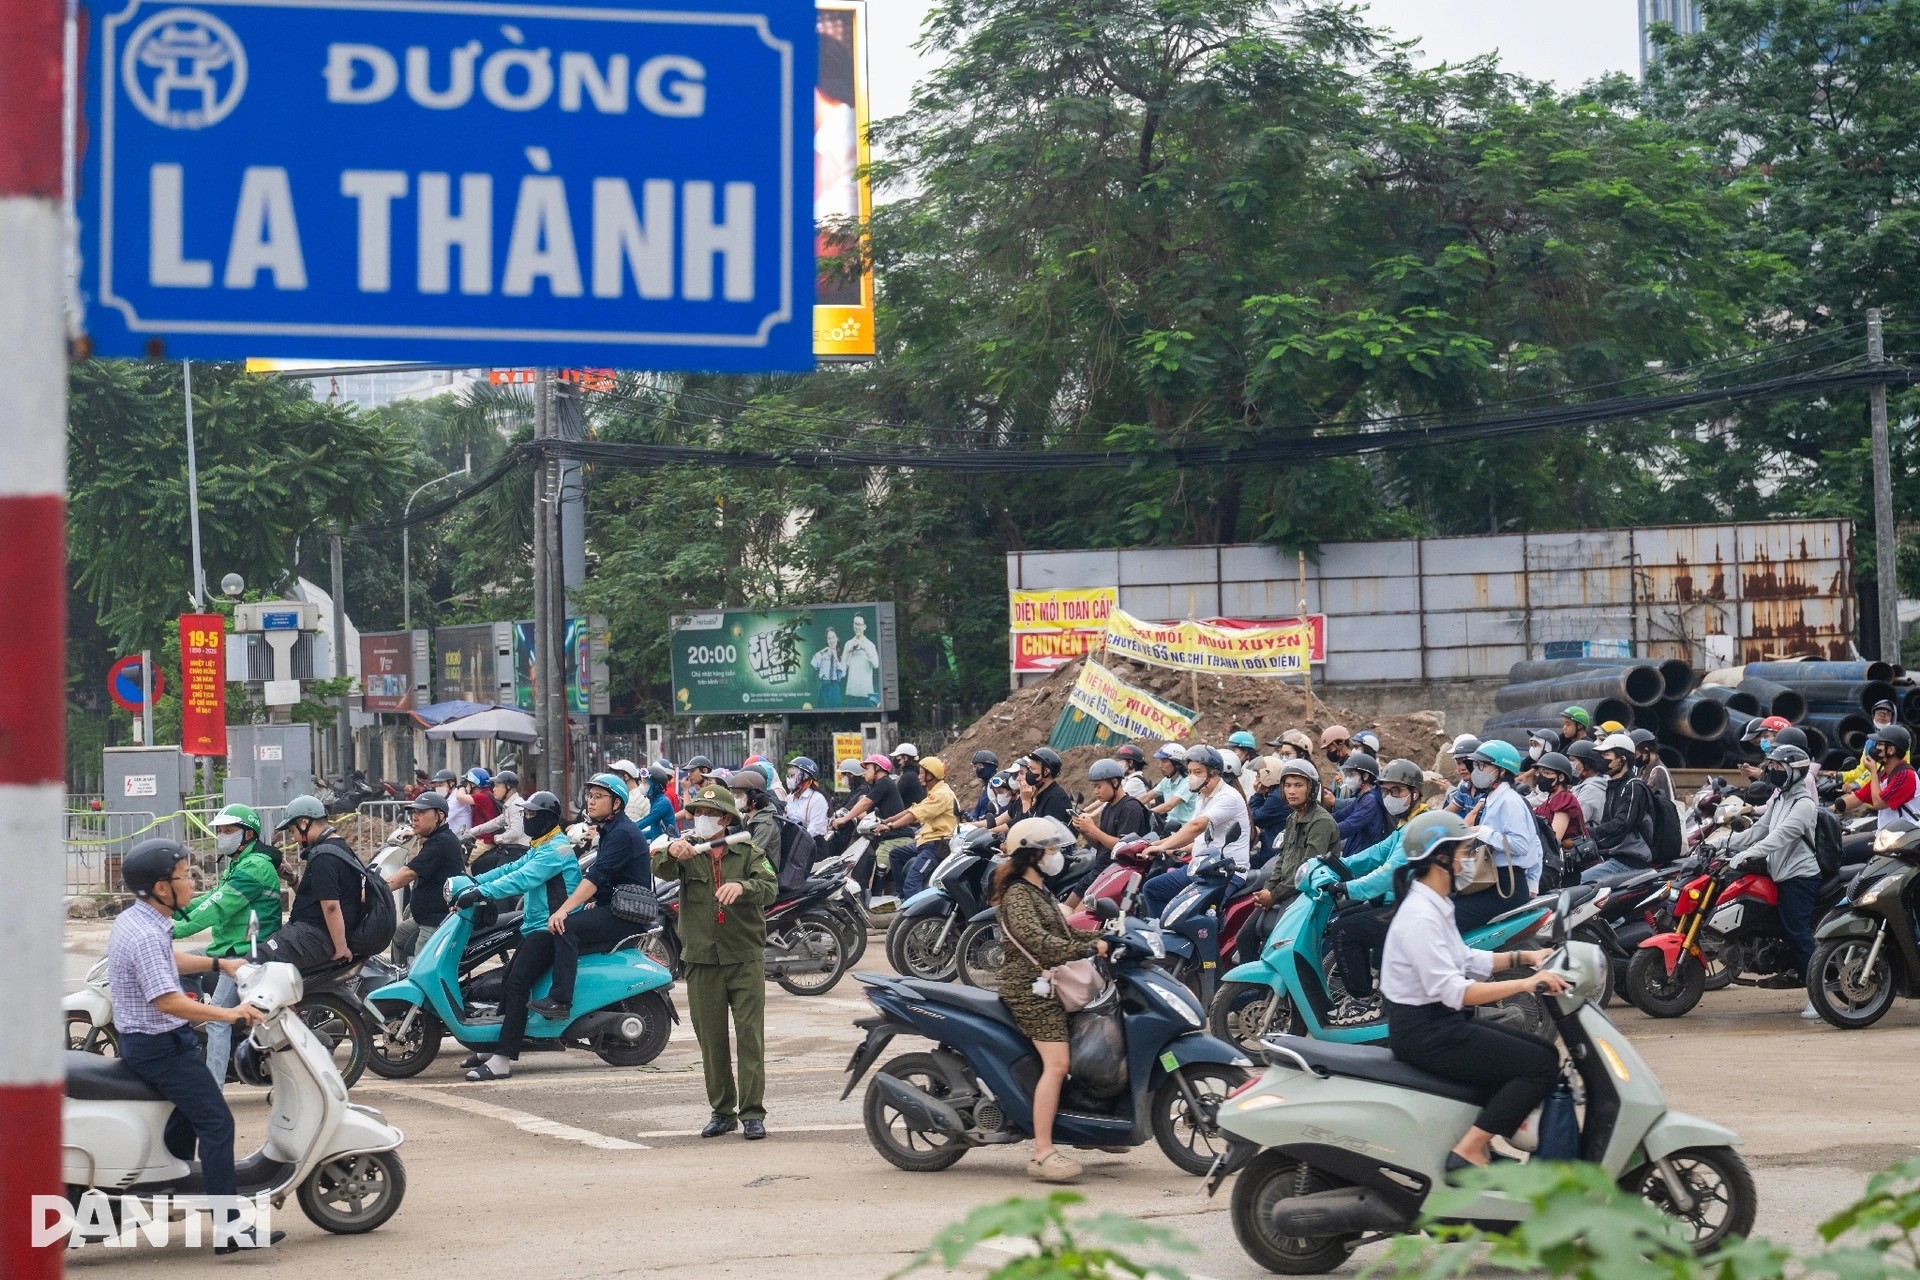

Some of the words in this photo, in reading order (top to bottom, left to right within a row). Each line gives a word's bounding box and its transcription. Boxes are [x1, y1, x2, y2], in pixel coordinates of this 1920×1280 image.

[323, 25, 706, 117] ĐƯỜNG
[149, 163, 308, 290] LA
[341, 146, 756, 302] THÀNH
[1015, 599, 1036, 626] DIỆT
[1040, 595, 1059, 621] MỐI
[1062, 597, 1089, 620] TOÀN
[687, 645, 737, 664] 20:00
[1152, 643, 1168, 661] 65
[1238, 634, 1300, 651] XUYÊN
